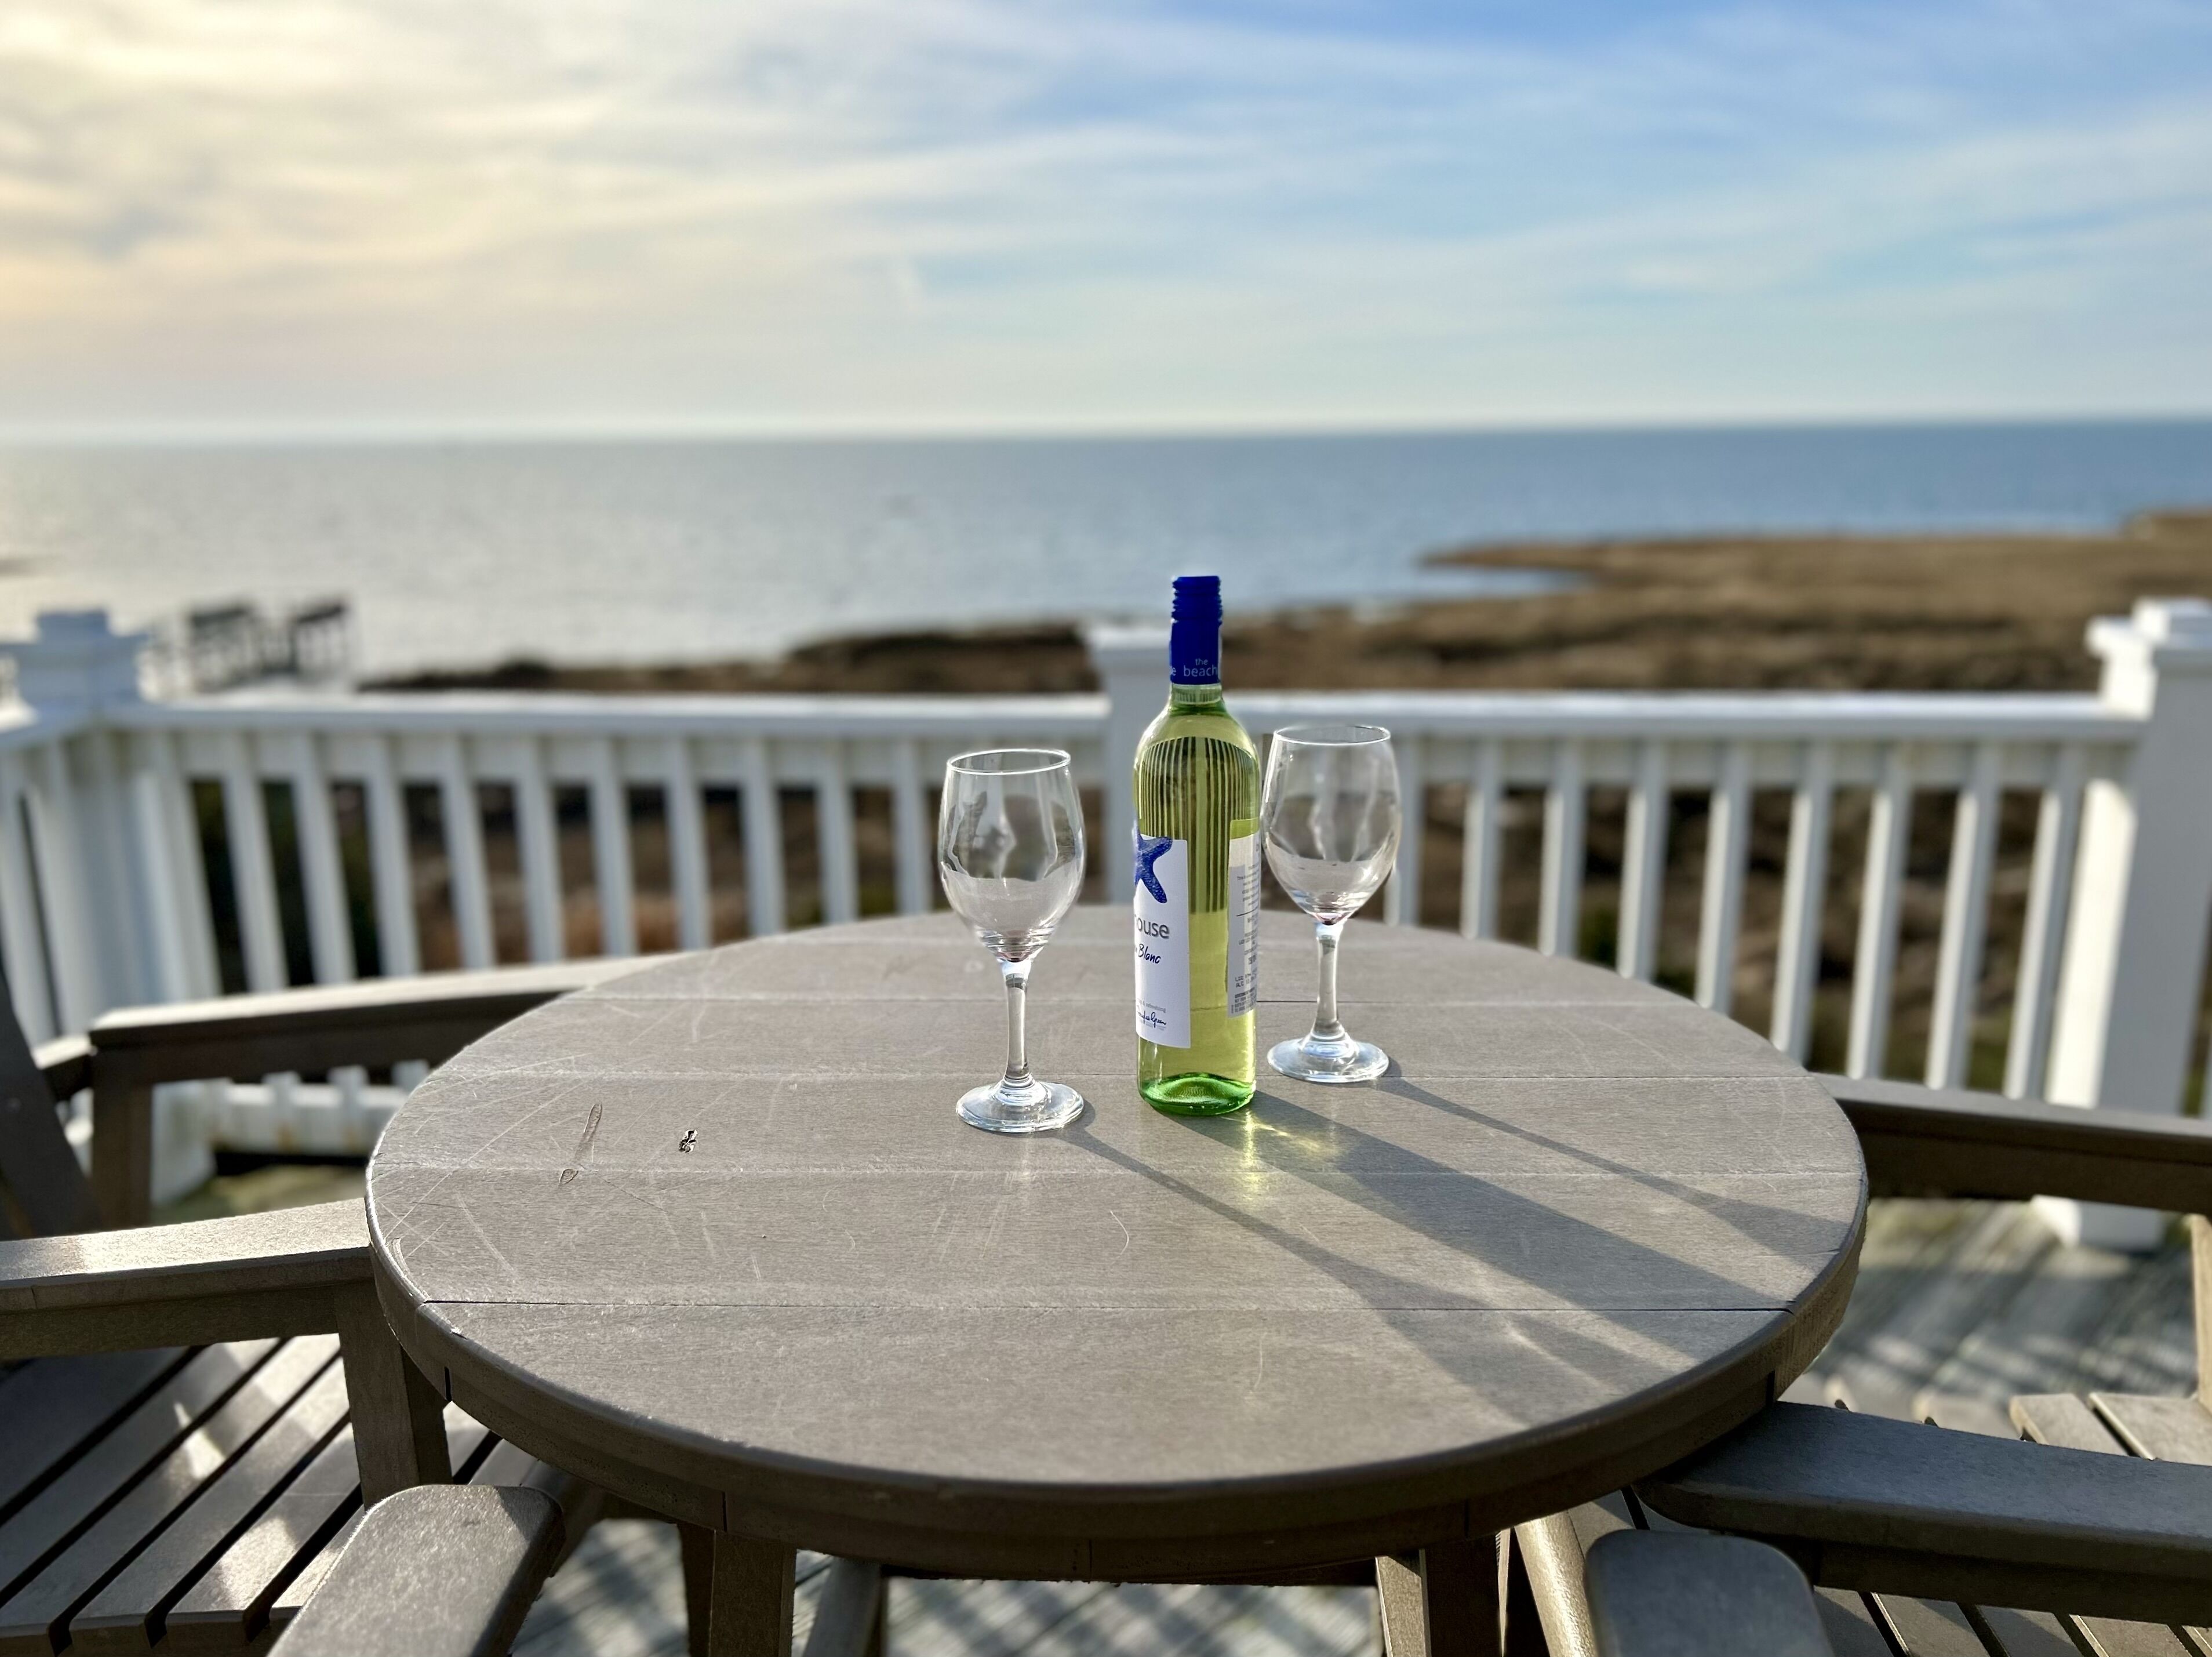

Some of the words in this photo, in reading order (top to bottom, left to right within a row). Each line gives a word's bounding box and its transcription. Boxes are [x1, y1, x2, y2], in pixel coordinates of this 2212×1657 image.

[1184, 664, 1217, 677] beach
[1134, 914, 1169, 939] ouse
[1138, 943, 1161, 964] Blanc
